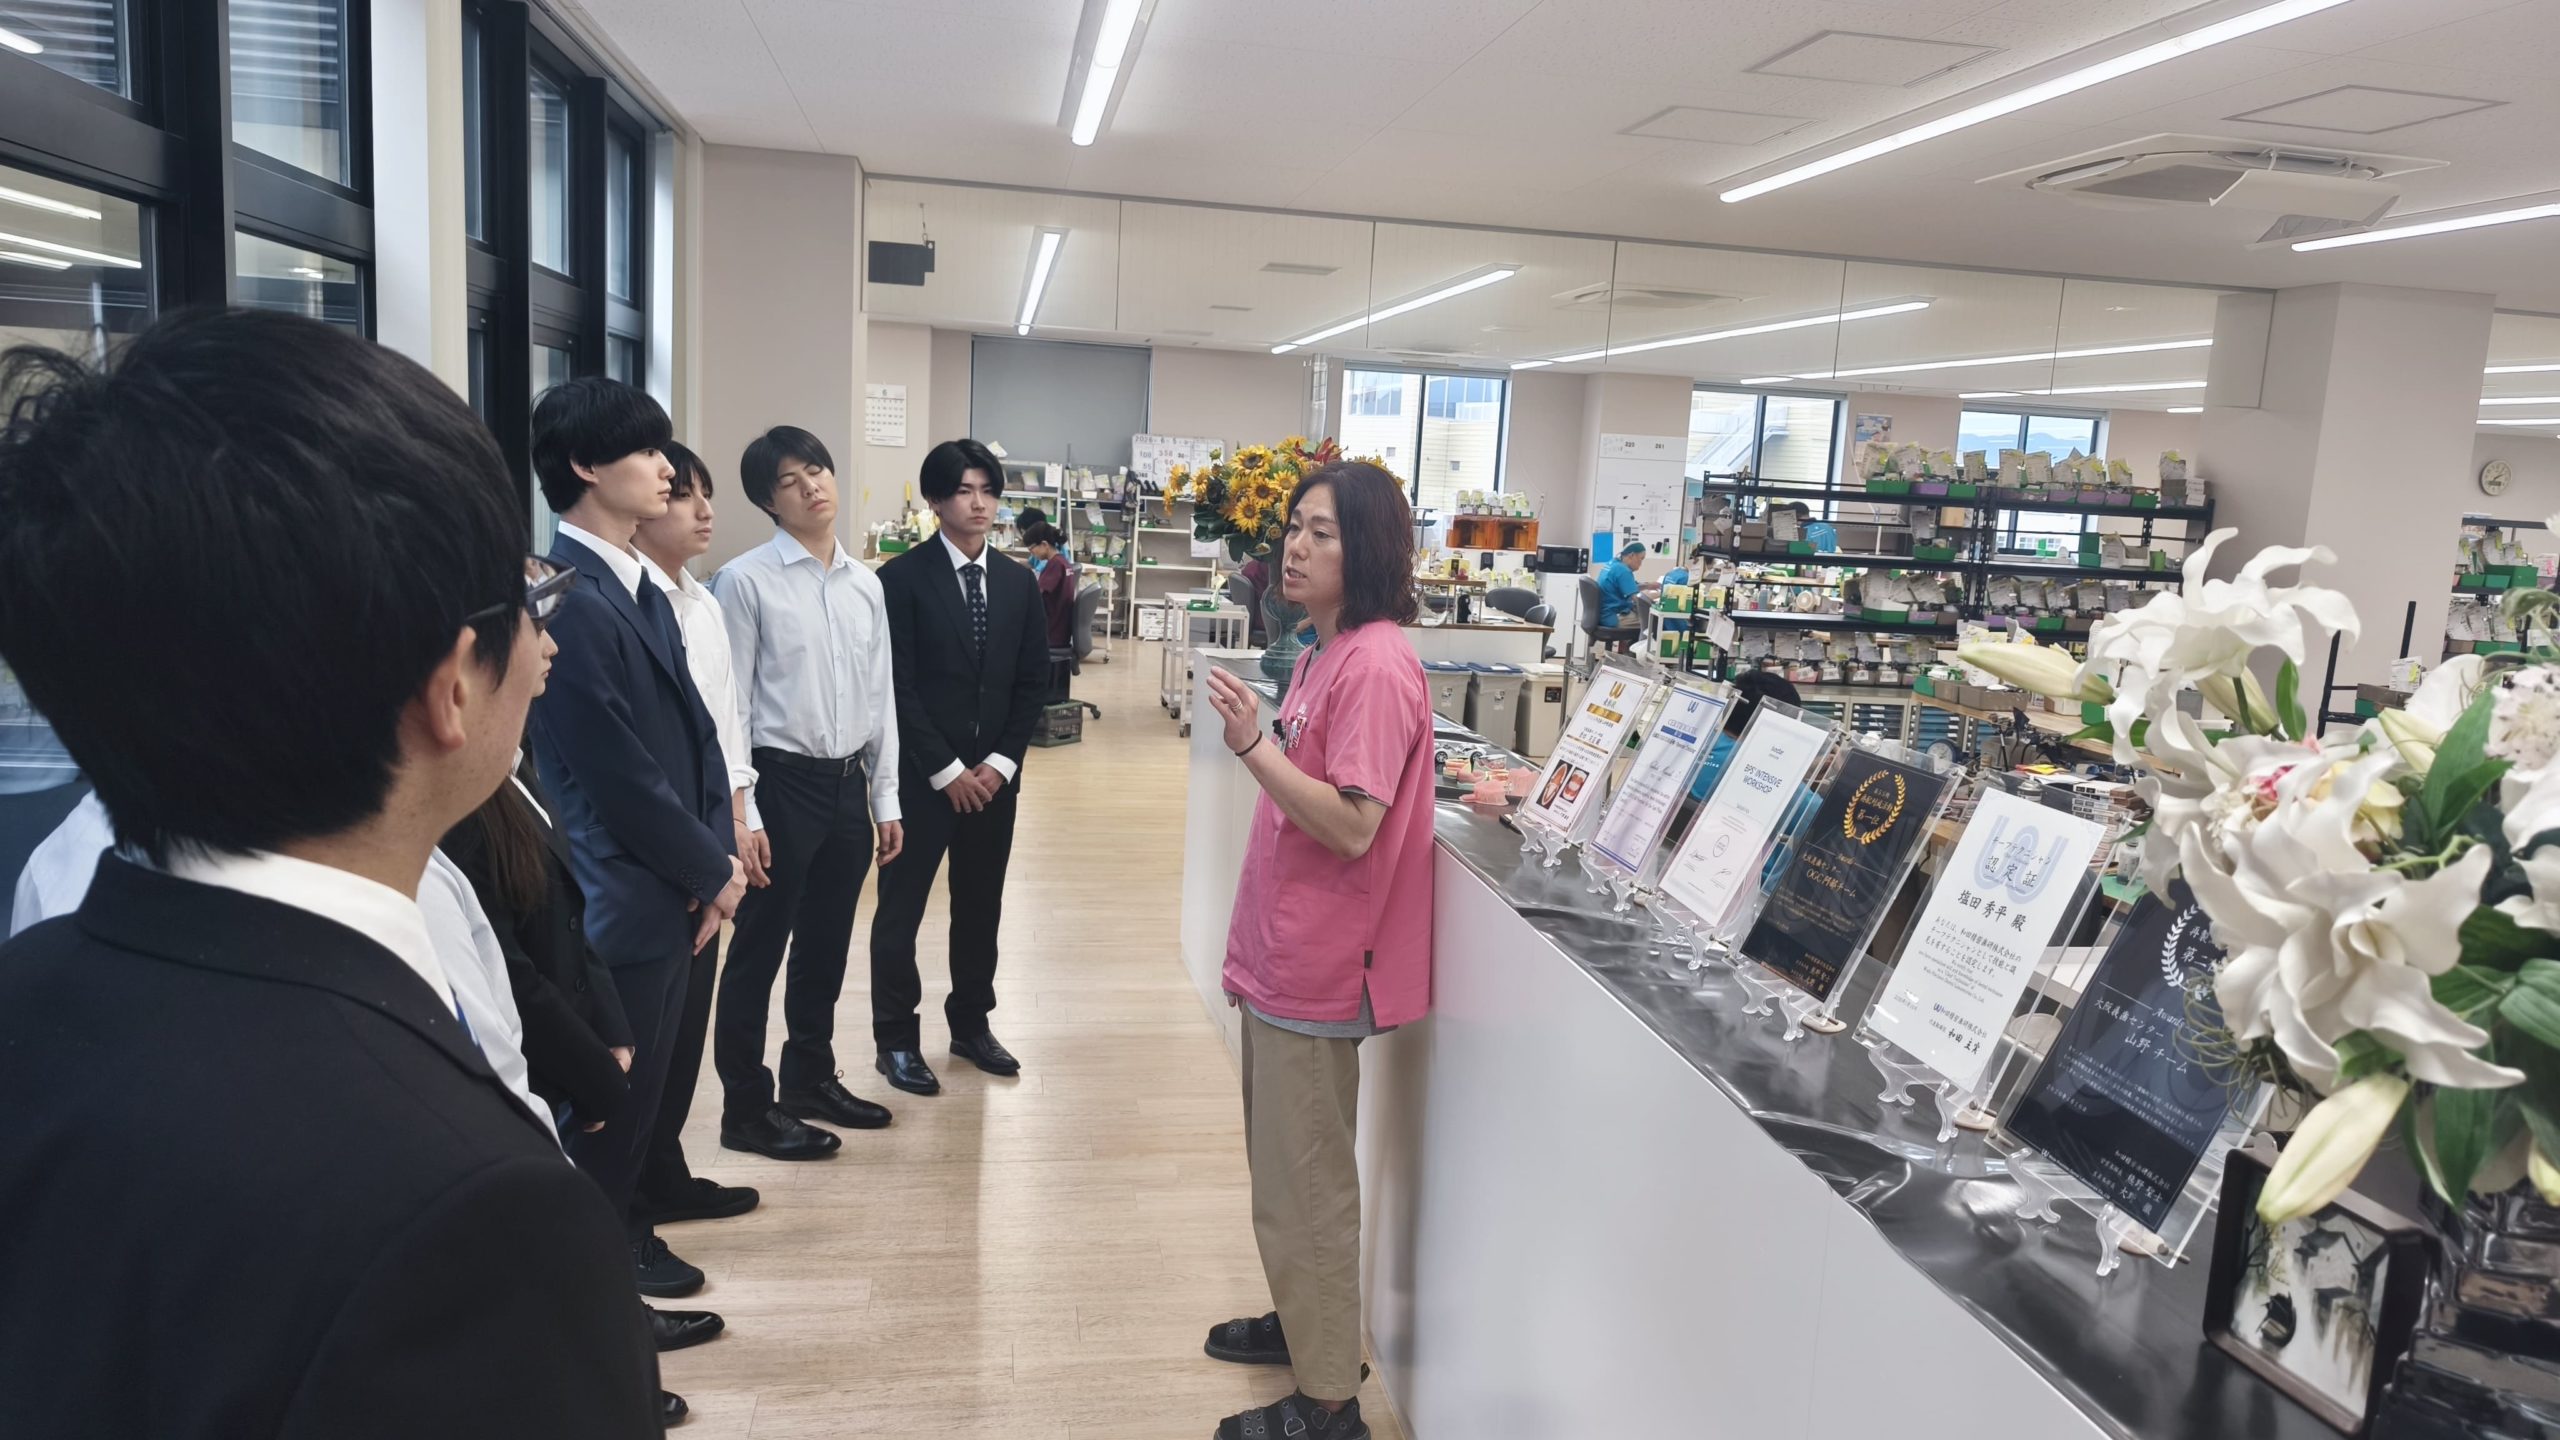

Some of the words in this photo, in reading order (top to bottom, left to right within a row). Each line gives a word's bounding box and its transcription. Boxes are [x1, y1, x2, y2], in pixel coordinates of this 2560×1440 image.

[1743, 776, 1773, 794] WORKSHOP
[1755, 769, 1782, 788] INTENSIVE
[1958, 890, 1982, 909] 塩田
[1983, 901, 2007, 921] 秀平
[2012, 914, 2026, 932] 殿
[2096, 999, 2163, 1037] 大阪義歯センター
[2124, 1033, 2151, 1053] 山野
[2154, 1048, 2187, 1074] チーム
